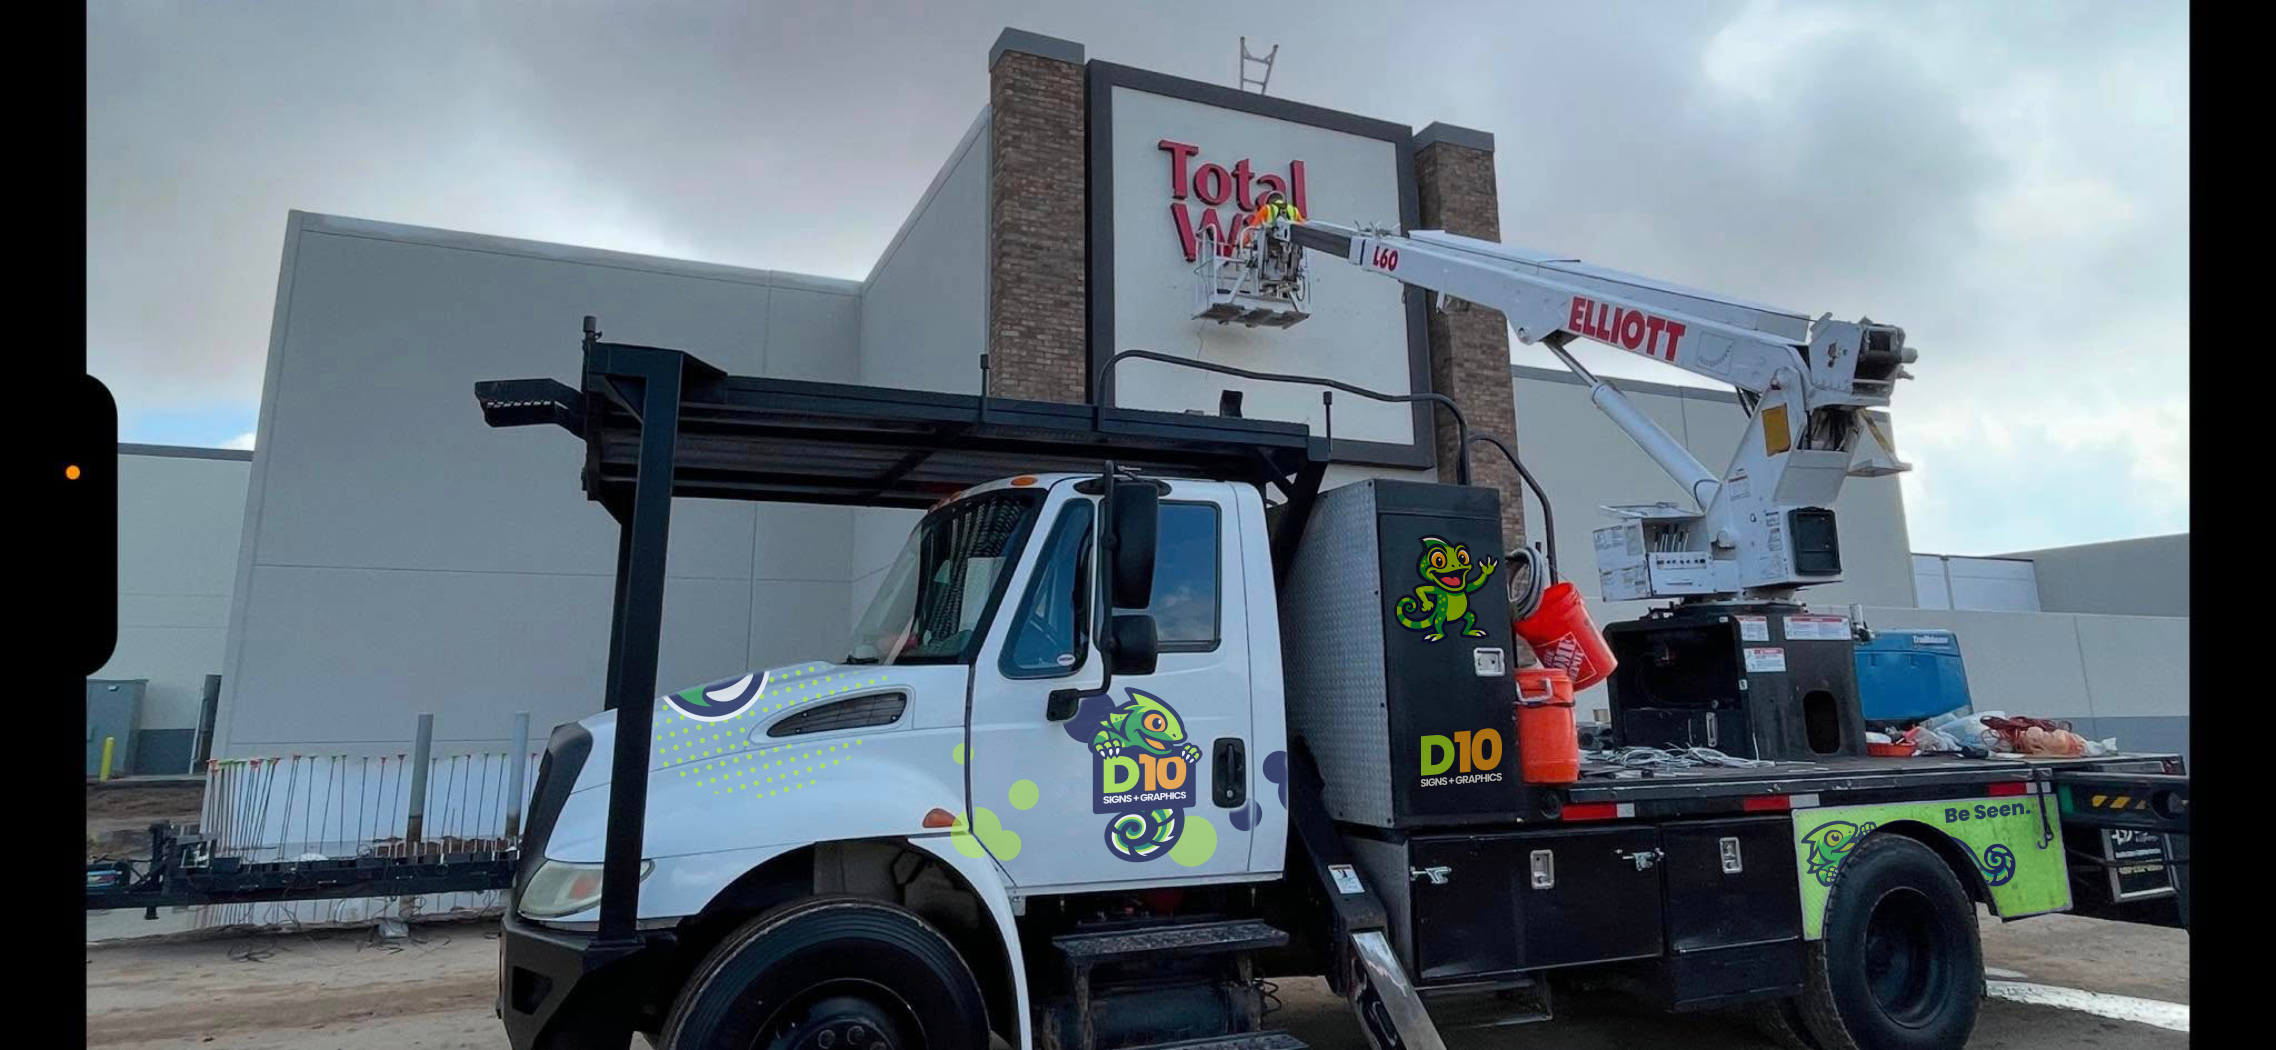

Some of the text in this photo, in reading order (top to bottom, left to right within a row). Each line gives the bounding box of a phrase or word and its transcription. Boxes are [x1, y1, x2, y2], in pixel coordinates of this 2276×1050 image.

[1158, 139, 1307, 220] Total
[1373, 245, 1398, 272] L60
[1568, 296, 1686, 362] ELLIOTT
[1421, 728, 1502, 776] D10
[1103, 754, 1187, 794] D10
[1420, 776, 1448, 788] SIGNS
[1455, 772, 1502, 785] GRAPHICS
[1103, 794, 1132, 804] SIGNS
[1140, 791, 1187, 802] GRAPHICS
[1945, 803, 2031, 823] Be Seen.
